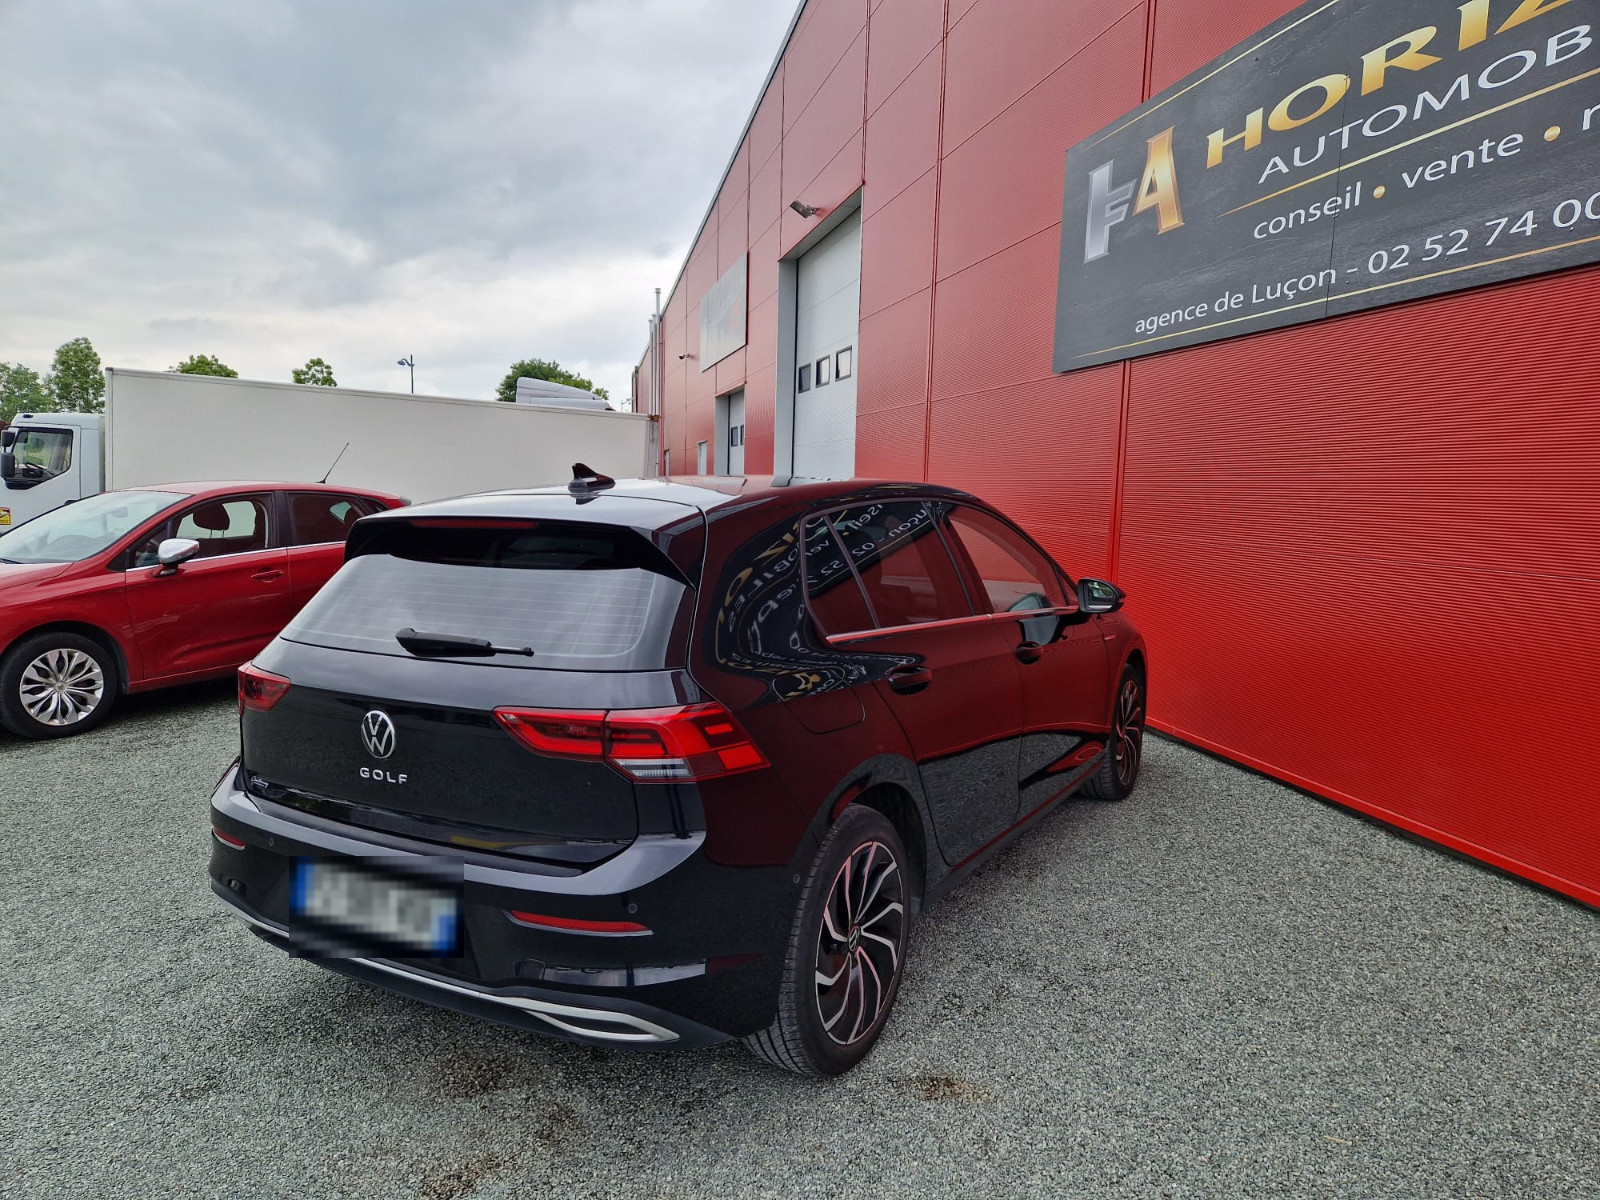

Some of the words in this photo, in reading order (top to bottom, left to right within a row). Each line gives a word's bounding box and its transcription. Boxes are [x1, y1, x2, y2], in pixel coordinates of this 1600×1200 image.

[1258, 24, 1593, 184] AUTOMOB
[1253, 181, 1361, 239] conseil
[1401, 133, 1524, 190] vente
[1135, 301, 1208, 335] agence
[1214, 291, 1245, 314] de
[1252, 268, 1336, 304] Luçon
[1368, 244, 1409, 275] 02
[1420, 229, 1468, 262] 52
[1485, 210, 1538, 246] 74
[359, 767, 408, 785] GOLF
